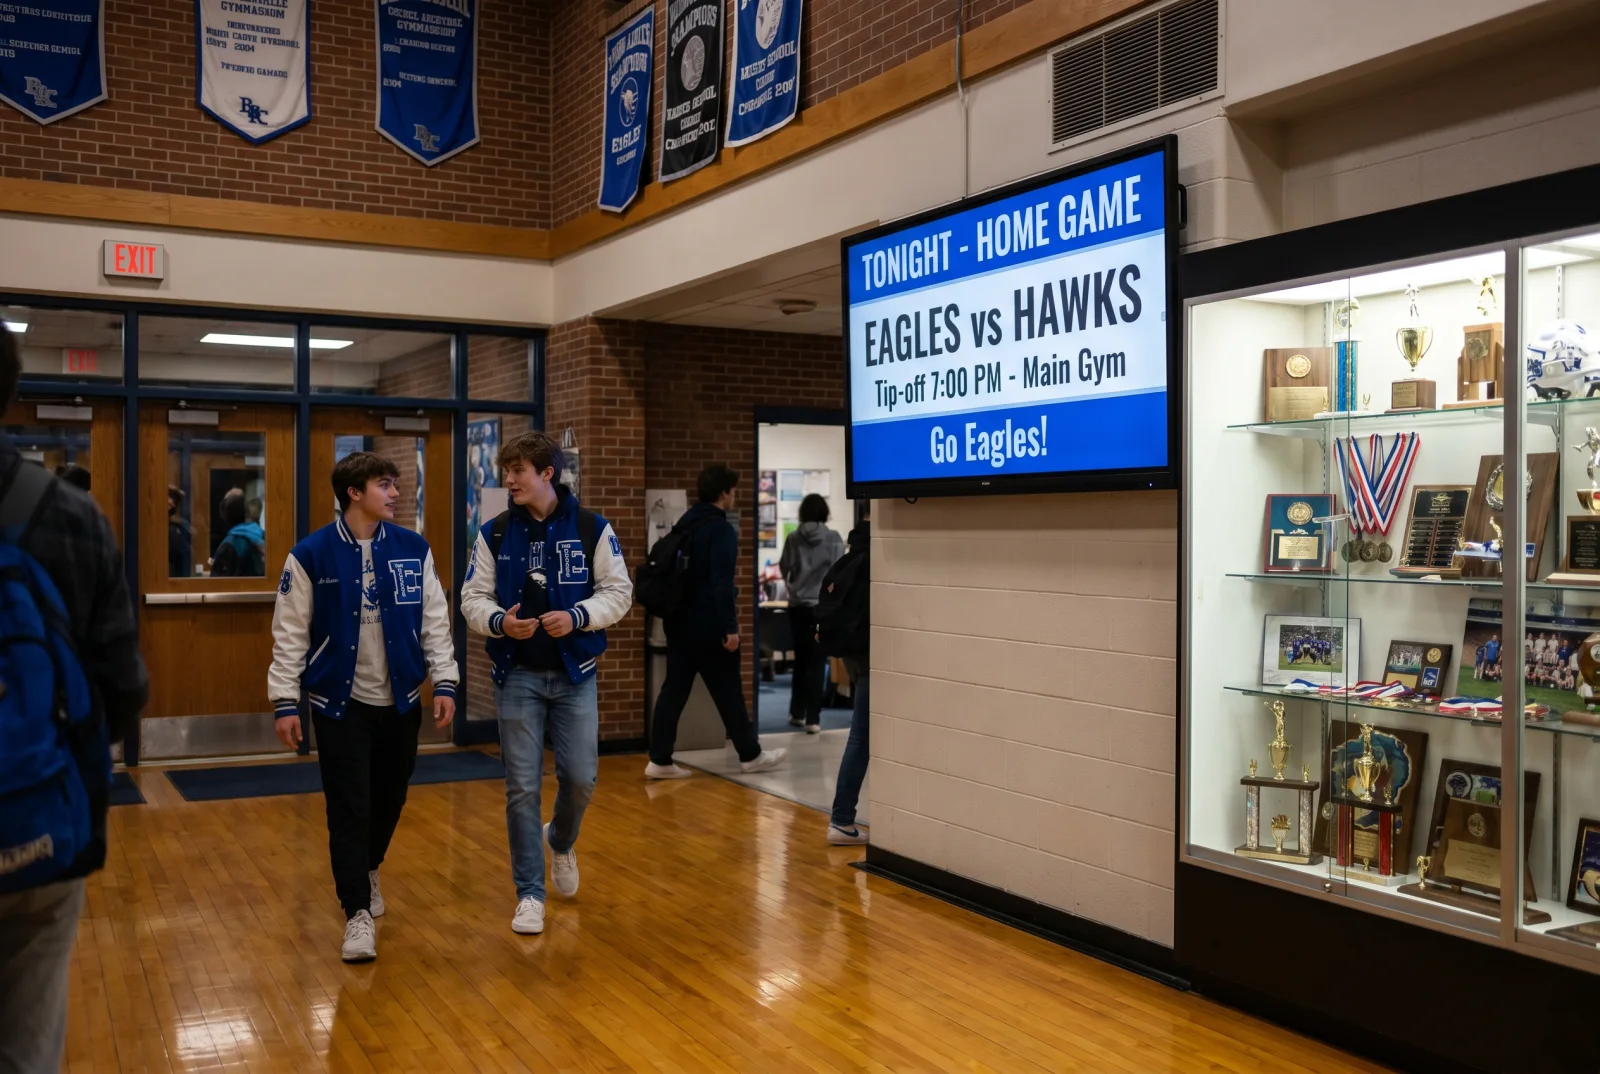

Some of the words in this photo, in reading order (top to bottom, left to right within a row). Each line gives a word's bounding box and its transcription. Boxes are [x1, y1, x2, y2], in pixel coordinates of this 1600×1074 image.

[115, 243, 157, 275] EXIT
[862, 230, 952, 291] TONIGHT
[977, 202, 1049, 262] HOME
[1058, 174, 1142, 241] GAME
[865, 303, 961, 368] EAGLES
[970, 308, 1003, 349] vs
[1014, 264, 1142, 342] HAWKS
[875, 374, 926, 412] Tip-off
[931, 367, 968, 400] 7:00
[974, 361, 1002, 395] PM
[1023, 353, 1071, 389] Main
[1078, 347, 1126, 386] Gym
[930, 425, 957, 464] Go
[965, 415, 1048, 468] Eagles!
[388, 558, 422, 605] E
[556, 539, 589, 585] E
